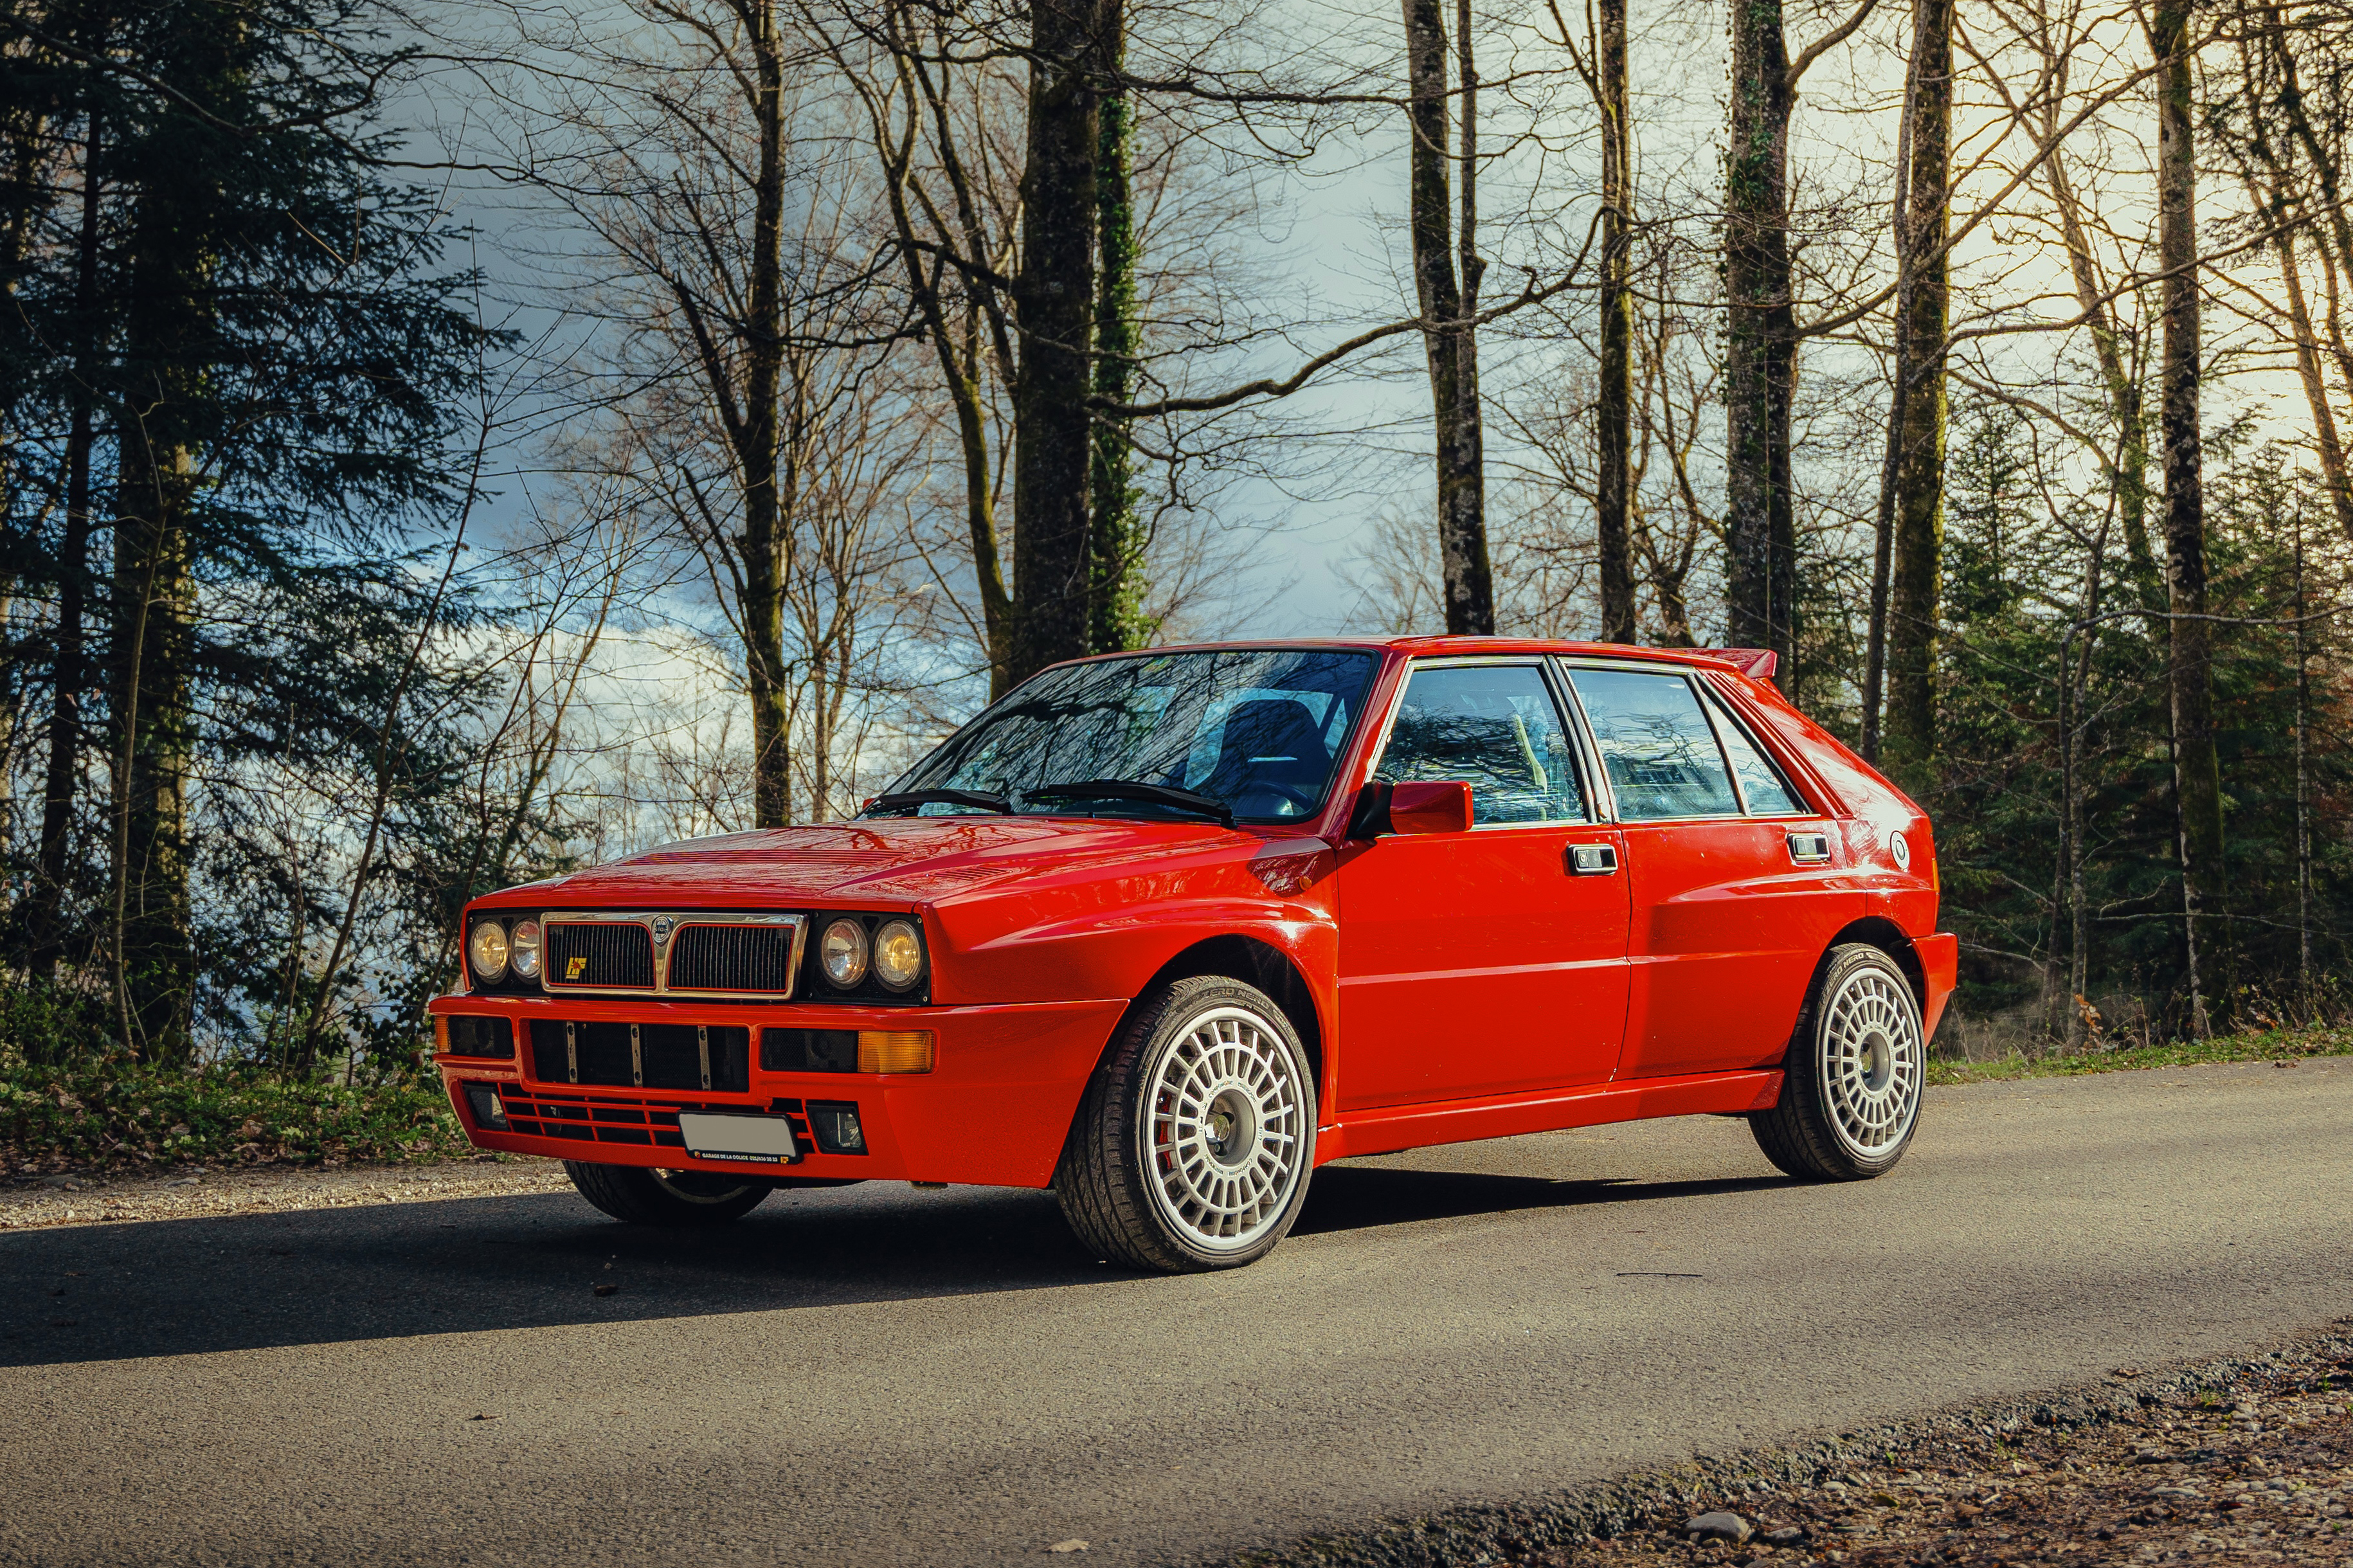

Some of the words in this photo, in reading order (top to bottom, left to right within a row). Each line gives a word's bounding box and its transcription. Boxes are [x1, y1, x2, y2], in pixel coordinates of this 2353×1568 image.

[1825, 965, 1844, 995] ZERO
[1843, 952, 1864, 969] NERO
[1237, 990, 1271, 1010] NERO
